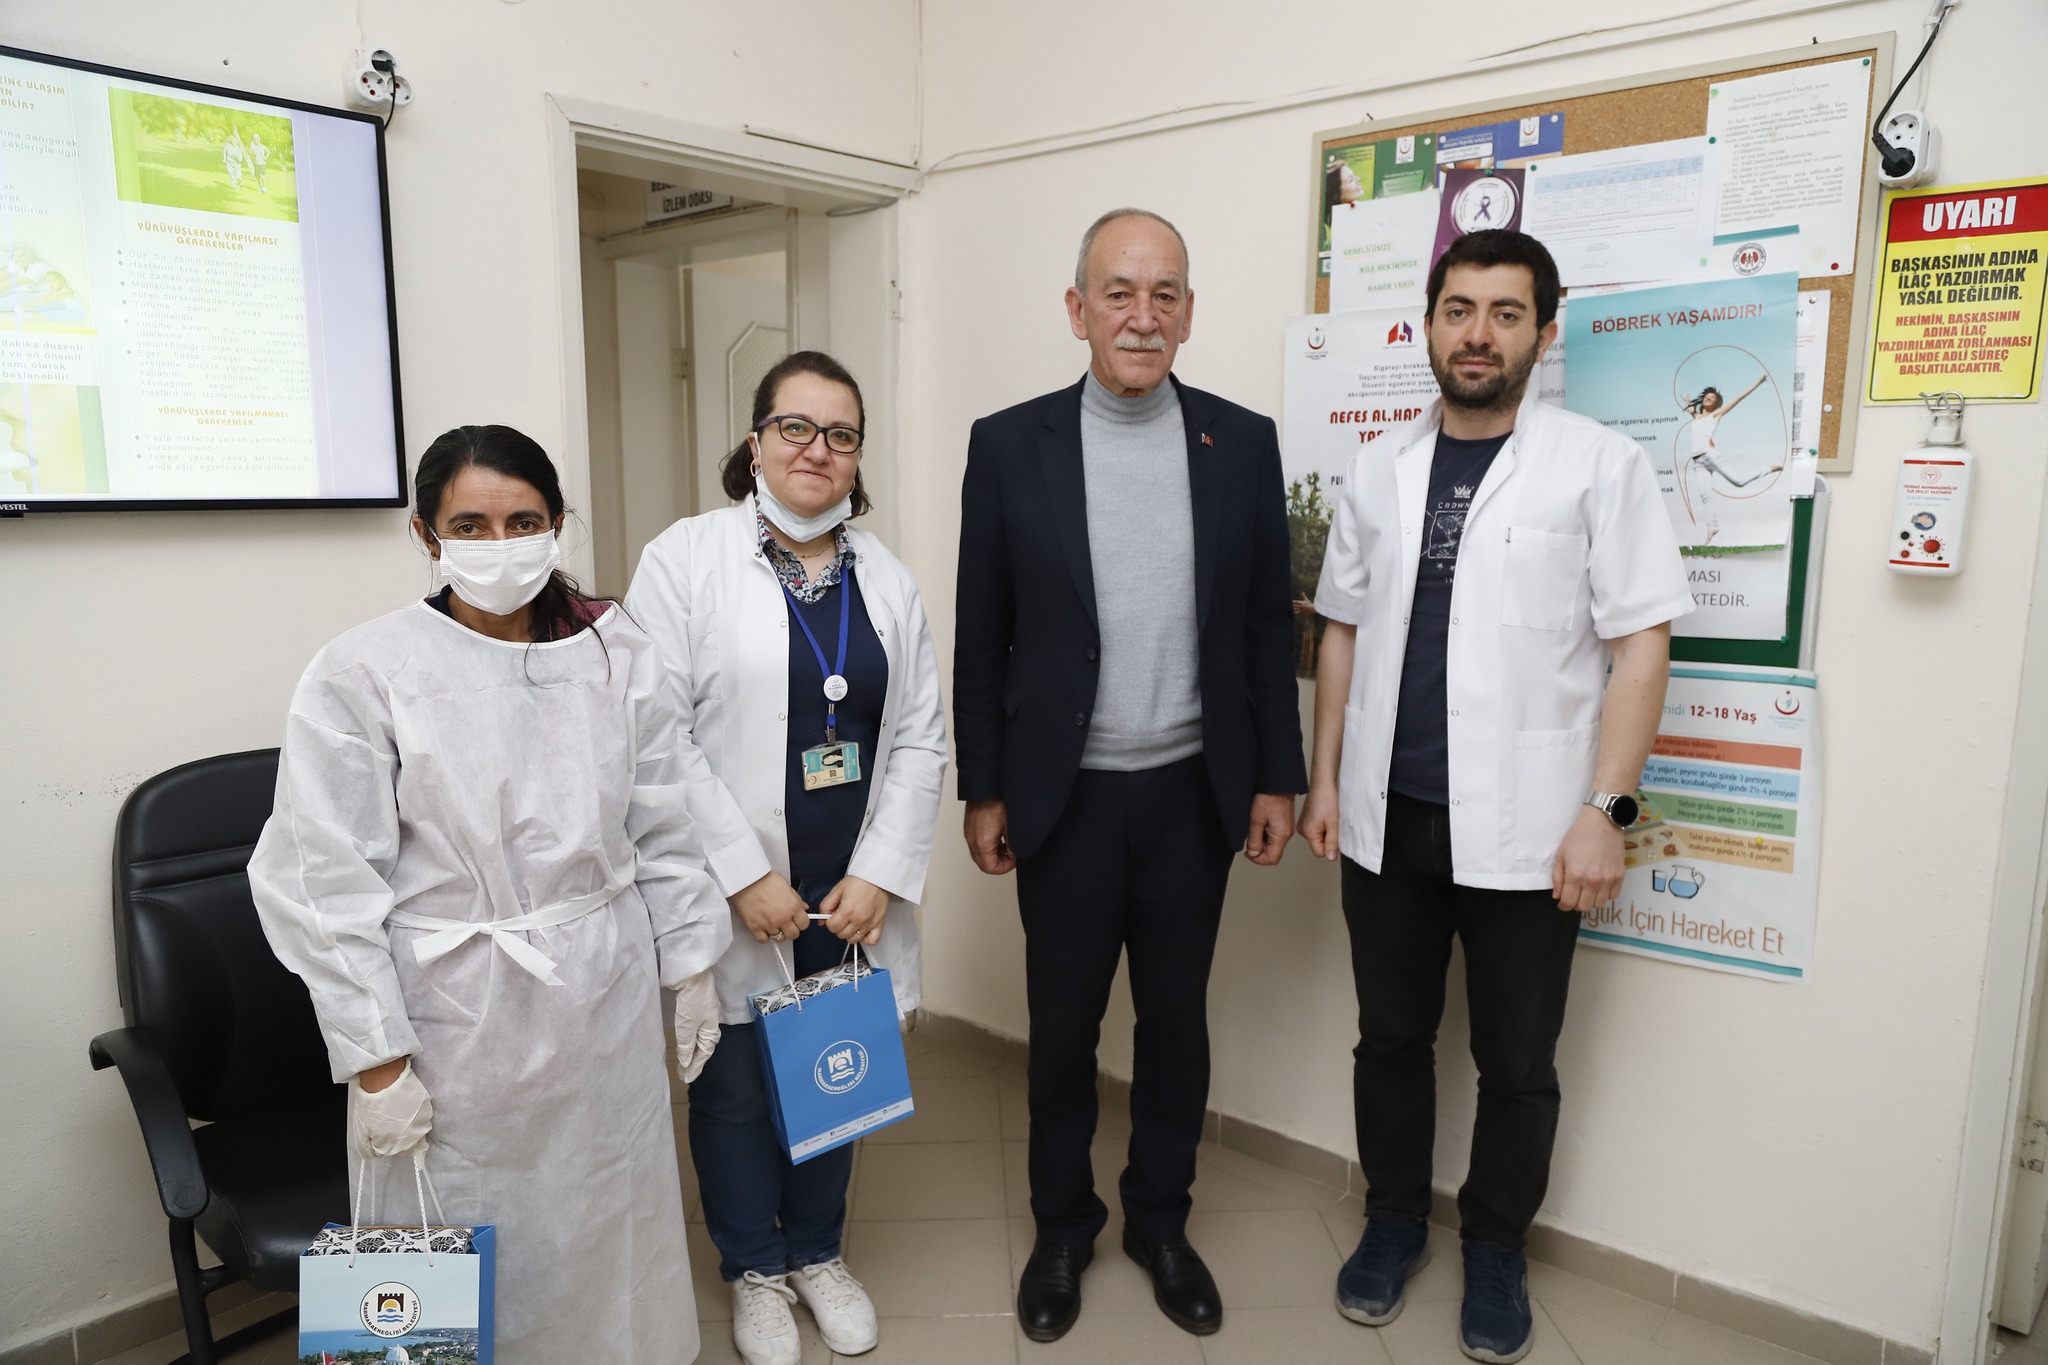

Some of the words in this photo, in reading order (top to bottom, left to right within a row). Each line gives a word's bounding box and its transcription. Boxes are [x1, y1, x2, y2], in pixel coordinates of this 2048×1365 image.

[27, 81, 65, 95] ULAŞIM
[0, 99, 35, 111] BİLİR?
[2, 140, 54, 154] cekleriyle
[1922, 196, 2017, 232] UYARI
[138, 221, 220, 240] YÜRÜYÜŞLERDE
[224, 232, 278, 246] YAPILMASI
[176, 237, 244, 251] GEREKENLER
[1891, 253, 1985, 274] BAŞKASININ
[1988, 249, 2039, 265] ADINA
[1897, 273, 1931, 290] İLAÇ
[1935, 267, 2027, 287] YAZDIRMAK
[1899, 289, 1943, 306] YASAL
[1946, 284, 2022, 303] DEĞİLDİR.
[1592, 314, 1662, 334] BÖBREK
[1667, 303, 1764, 327] YAŞAMDIR!
[1948, 310, 2021, 325] BAŞKASININ
[1923, 326, 1957, 338] ADINA
[1961, 324, 1987, 337] İLAÇ
[1, 340, 38, 349] dakika
[43, 341, 83, 352] düzenli
[1877, 338, 1954, 352] YAZDIRILMAYA
[1957, 335, 2033, 349] ZORLANMASI
[44, 351, 81, 361] önemli
[1894, 351, 1940, 364] HALİNDE
[1942, 349, 1968, 361] ADLİ
[1970, 348, 2009, 362] SÜREÇ
[31, 362, 66, 371] olarak
[1899, 362, 2003, 376] BAŞLATILACAKTIR.
[158, 406, 227, 416] YÜRÜYÜŞLERDE
[230, 409, 288, 418] YAPILMAMASI
[1330, 410, 1368, 424] NEFES
[197, 417, 254, 426] GEREKENLER
[1620, 417, 1650, 427] egzersiz
[1651, 415, 1679, 426] yapmak
[1688, 570, 1721, 583] MASI
[1691, 592, 1750, 607] KTEDİR.
[1690, 705, 1729, 719] 12-18
[1734, 707, 1757, 725] Yaş
[1630, 900, 1664, 936] İçin
[1671, 910, 1755, 950] Hareket
[1762, 925, 1785, 956] Et
[401, 1299, 419, 1332] BELEDİYESİ
